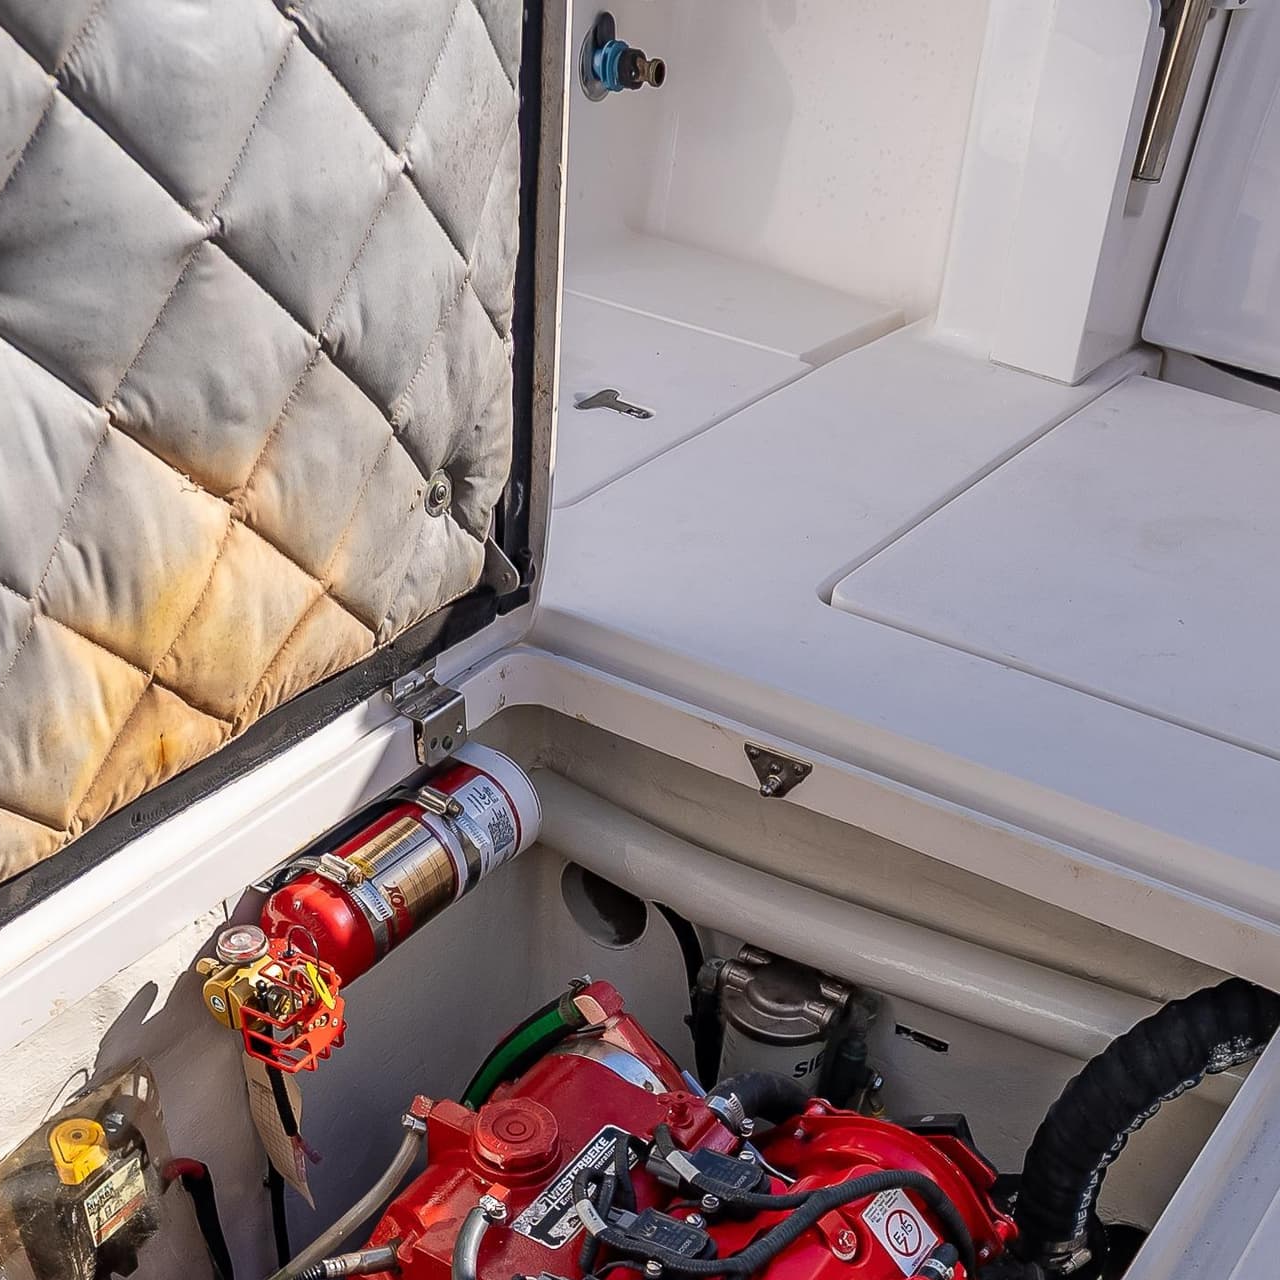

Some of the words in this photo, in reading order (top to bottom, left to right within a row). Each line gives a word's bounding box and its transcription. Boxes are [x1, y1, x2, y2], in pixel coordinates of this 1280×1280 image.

[793, 1052, 824, 1078] SIE
[548, 1137, 609, 1201] WESTERBEKE
[893, 1220, 913, 1245] E-15
